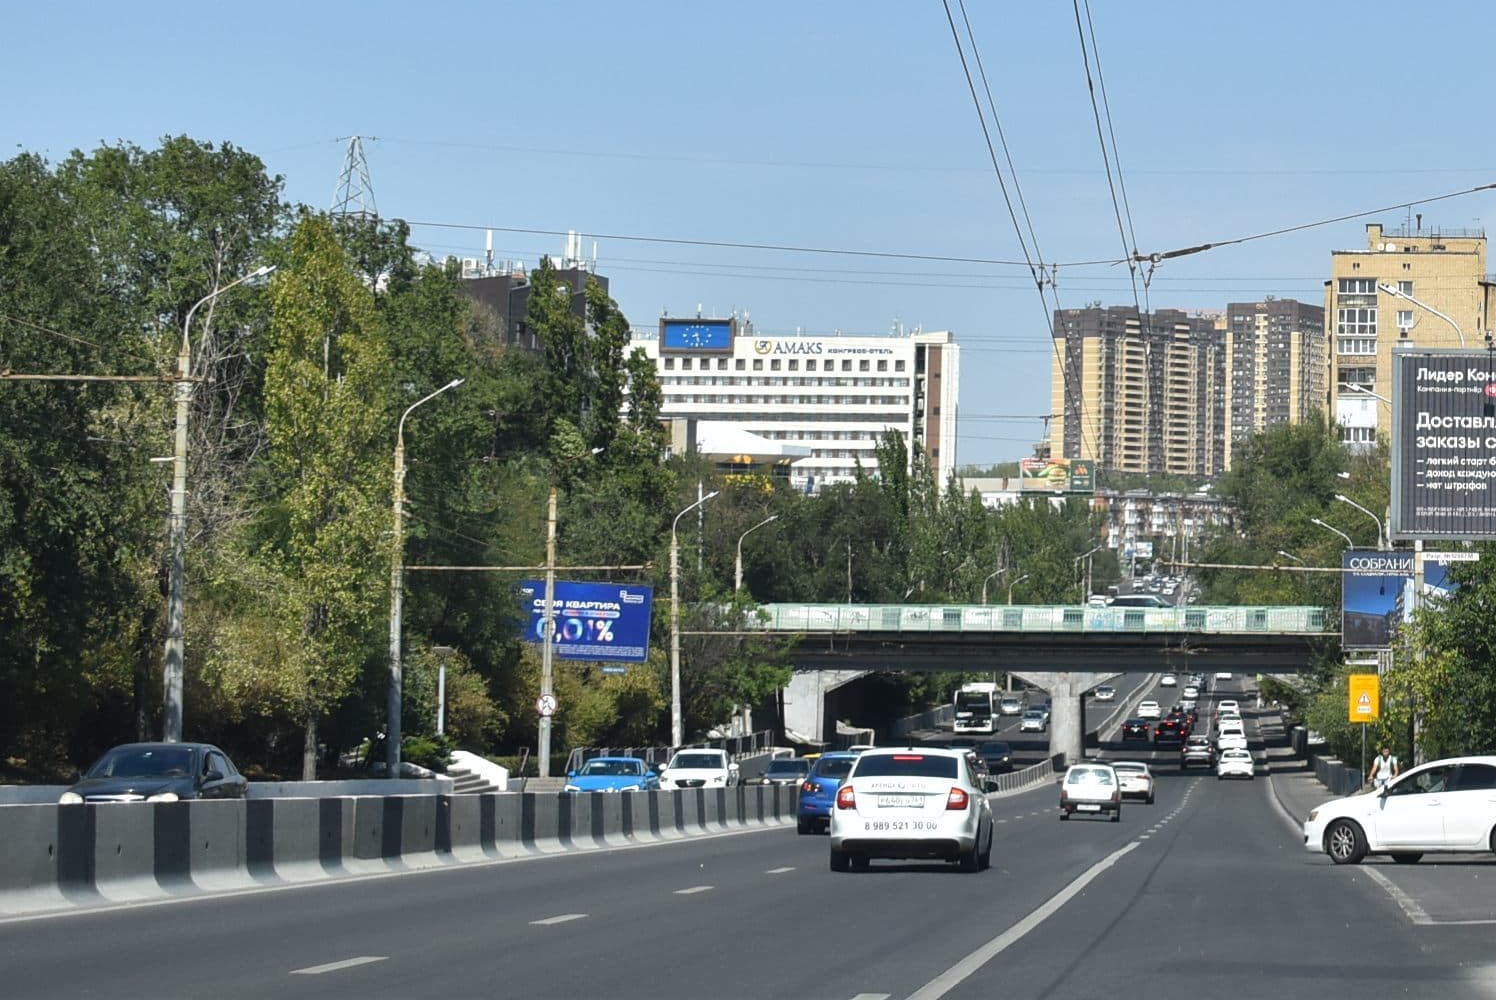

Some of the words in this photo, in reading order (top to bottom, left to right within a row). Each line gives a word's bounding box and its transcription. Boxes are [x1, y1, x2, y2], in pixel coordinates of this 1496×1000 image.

[773, 341, 823, 355] AMAKS
[1416, 367, 1464, 384] Лидер
[1416, 435, 1480, 449] заказы
[1484, 437, 1496, 449] с
[1460, 457, 1487, 468] старт
[1425, 469, 1455, 479] доход
[1457, 470, 1496, 480] каждую
[565, 600, 621, 611] КВАРТИРА
[864, 822, 870, 831] 8
[873, 822, 890, 831] 989
[892, 822, 909, 830] 521
[912, 821, 924, 830] 30
